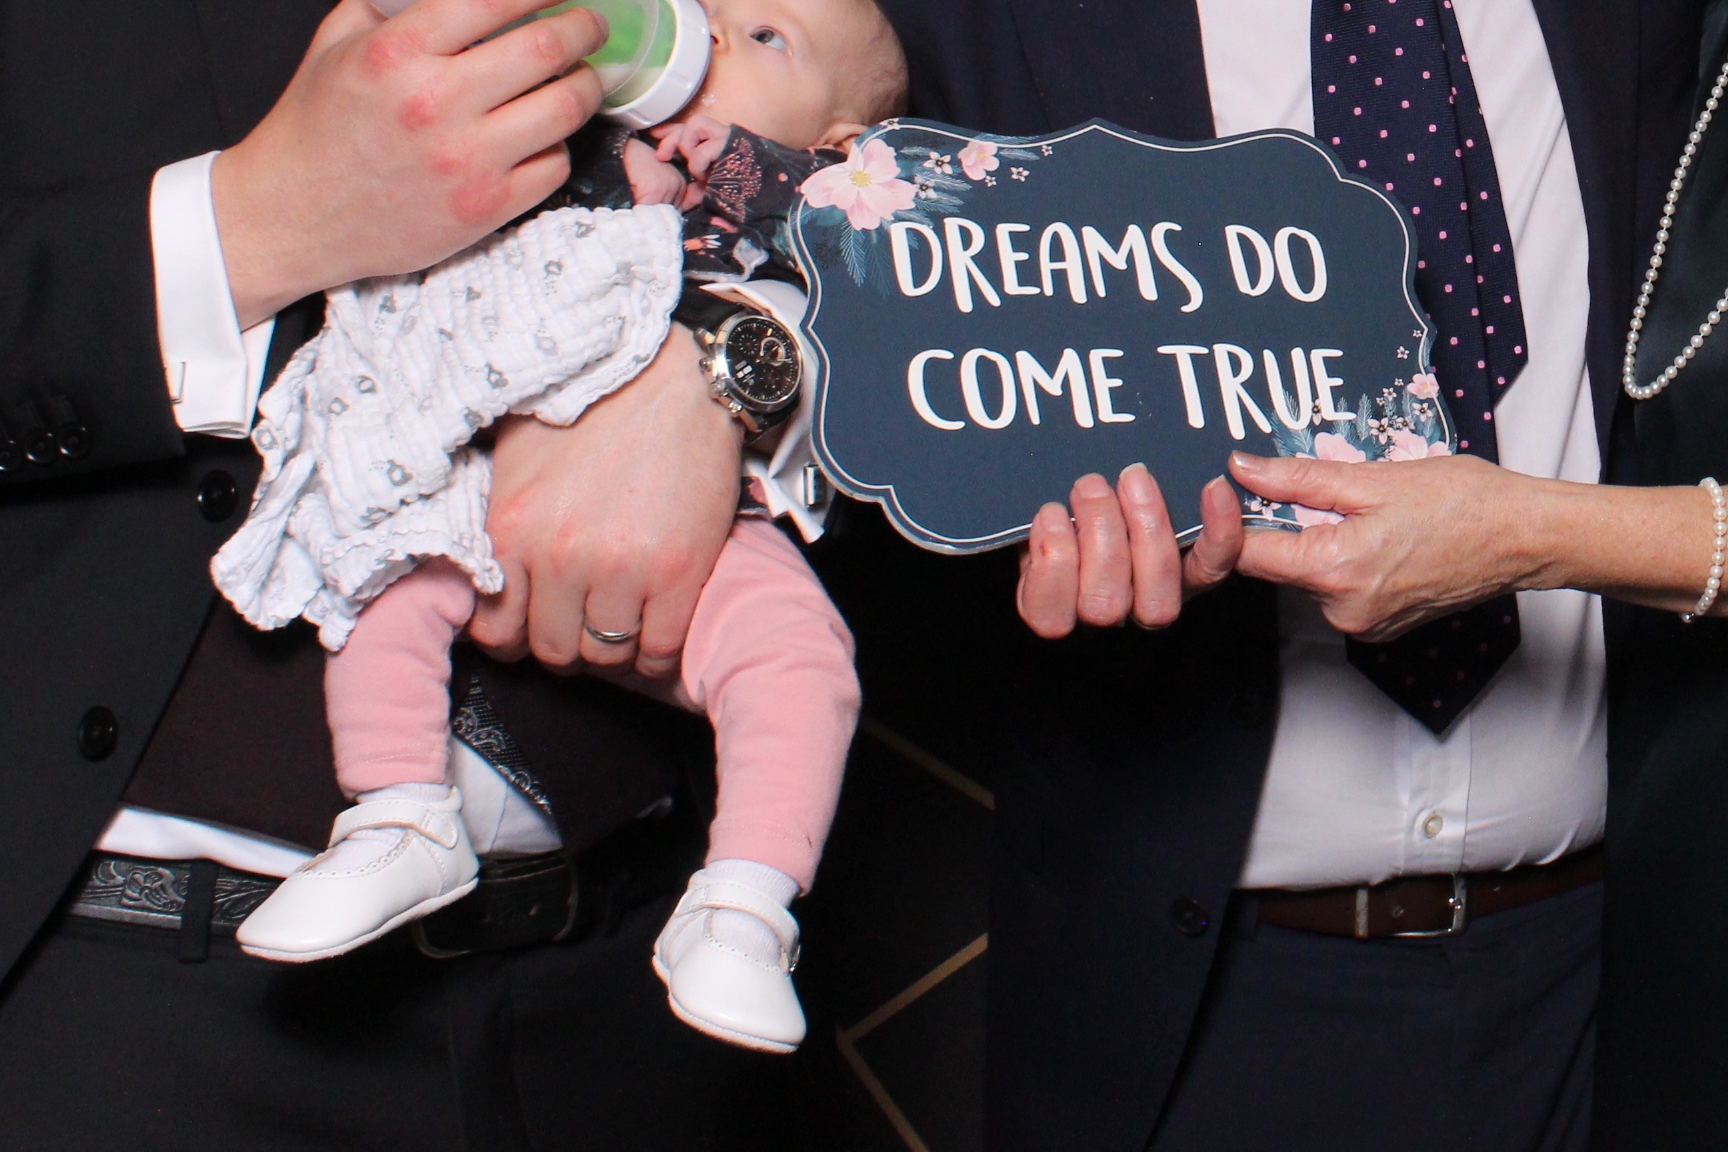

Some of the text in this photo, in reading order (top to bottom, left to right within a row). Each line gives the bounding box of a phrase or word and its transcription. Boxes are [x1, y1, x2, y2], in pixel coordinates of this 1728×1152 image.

[890, 217, 1328, 313] DREAMS DO
[907, 343, 1358, 441] COME TRUE
